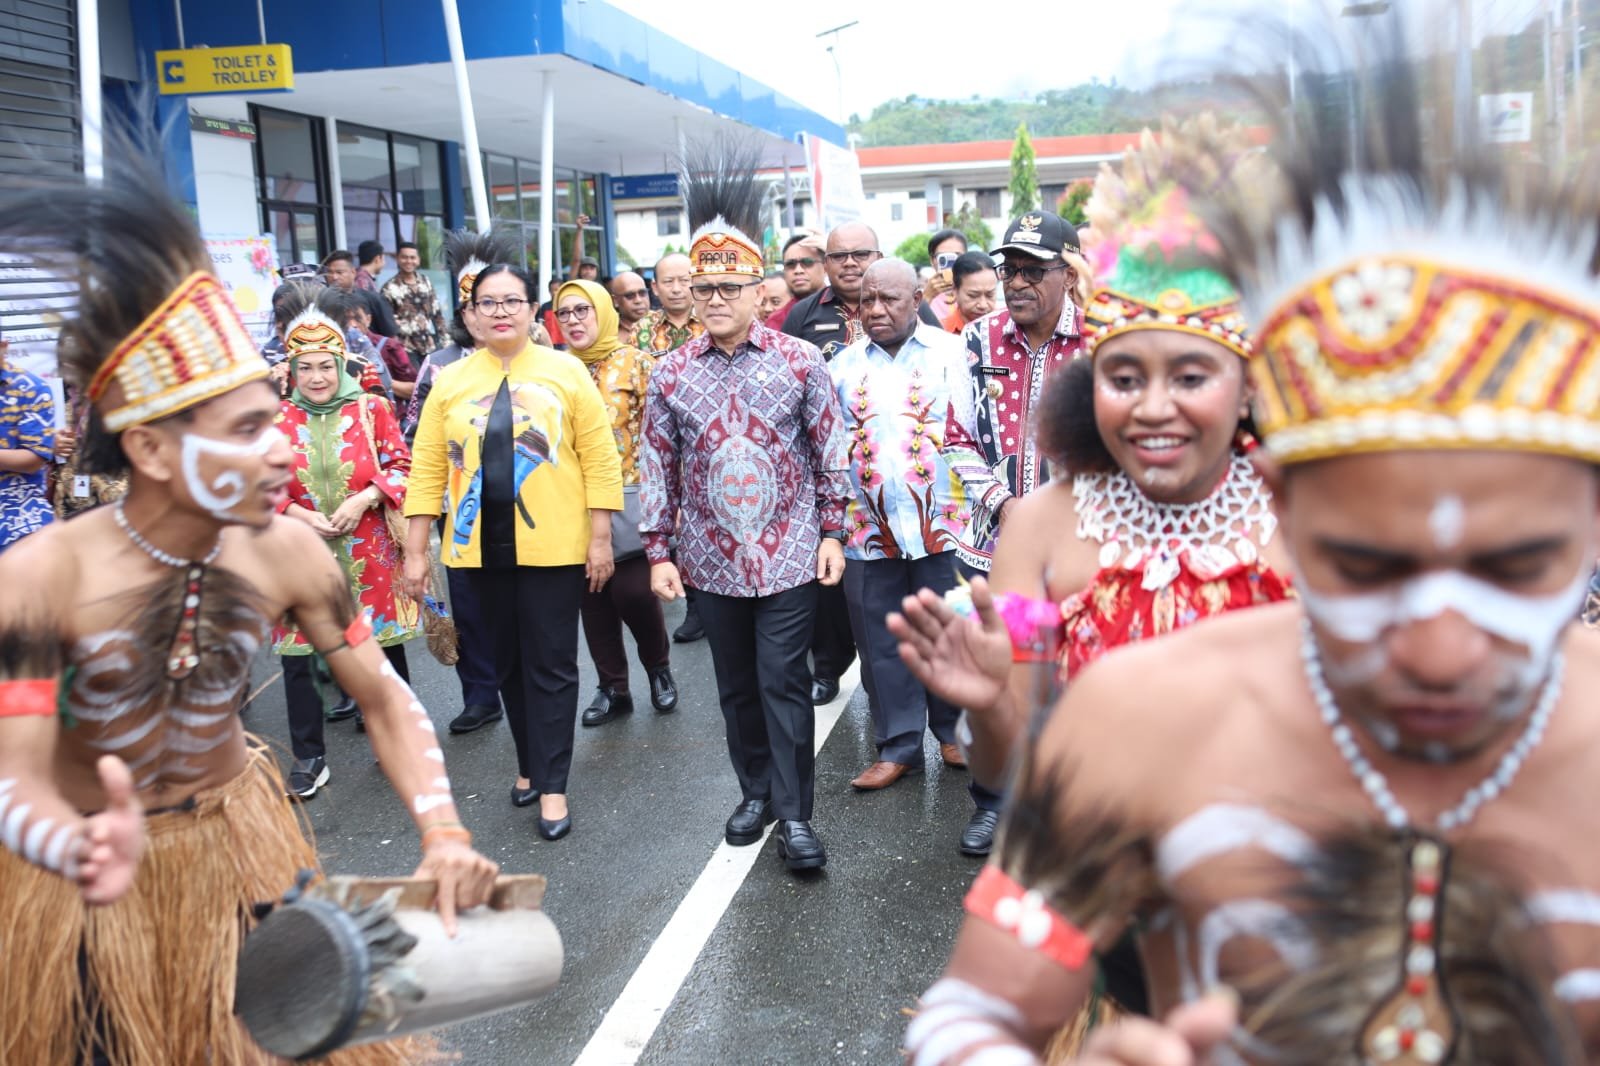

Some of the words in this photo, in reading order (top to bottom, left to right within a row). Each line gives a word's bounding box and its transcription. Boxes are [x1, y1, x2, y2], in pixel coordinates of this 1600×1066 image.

[212, 55, 260, 69] TOILET
[266, 54, 276, 66] &
[212, 70, 276, 84] TROLLEY
[700, 252, 736, 265] PAPUA
